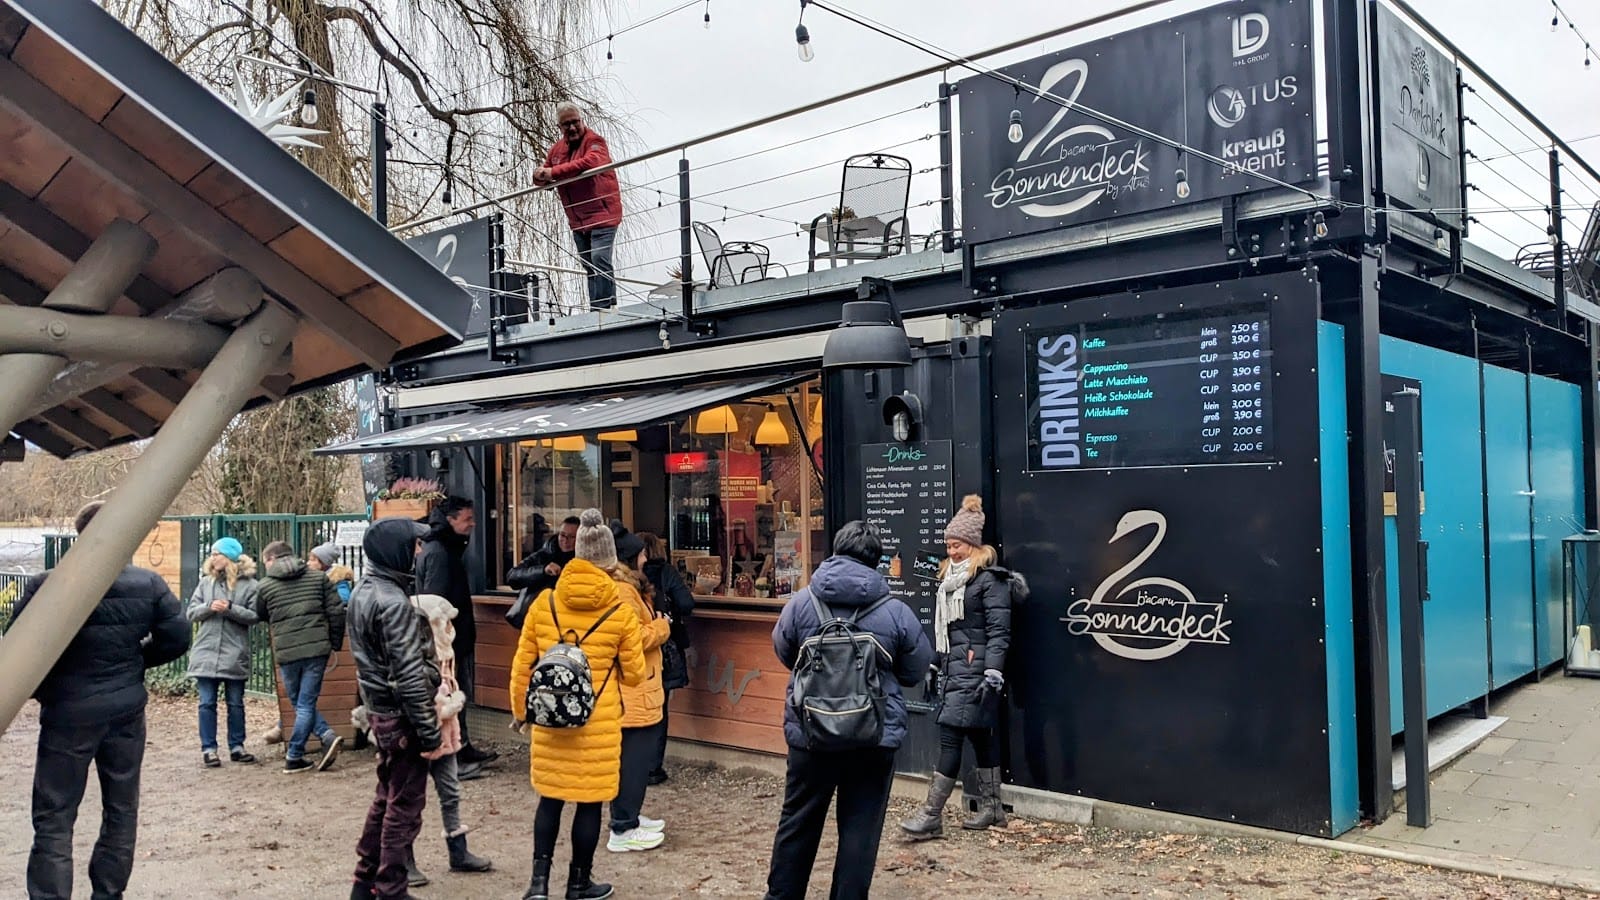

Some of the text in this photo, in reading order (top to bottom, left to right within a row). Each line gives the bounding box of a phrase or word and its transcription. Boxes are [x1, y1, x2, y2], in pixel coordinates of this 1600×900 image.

[1247, 53, 1270, 64] GROUP
[1228, 75, 1298, 112] ATUS
[1222, 127, 1286, 159] krauß
[1059, 143, 1099, 161] bacaru
[1222, 148, 1286, 175] event
[984, 142, 1150, 208] Sonnendeck
[1105, 183, 1119, 199] by
[1201, 327, 1217, 336] klein
[1231, 322, 1259, 333] 2,50 €
[1082, 338, 1106, 349] Kaffee
[1200, 337, 1218, 350] groß
[1231, 333, 1260, 344] 3,90 €
[1199, 353, 1218, 363] CUP
[1232, 350, 1260, 360] 3,50 €
[1083, 361, 1129, 375] Cappuccino
[1232, 366, 1261, 377] 3,90 €
[1200, 369, 1219, 379] CUP
[1083, 374, 1149, 388] Latte Macchiato
[1200, 385, 1220, 395] CUP
[1231, 382, 1261, 393] 3,00 €
[1037, 334, 1081, 466] DRINKS
[1084, 388, 1154, 403] Heiße Schokolade
[1203, 401, 1220, 410] klein
[1231, 398, 1262, 409] 3,00 €
[1084, 405, 1129, 418] Milchkaffee
[1233, 410, 1262, 420] 3,90 €
[1203, 412, 1220, 424] groß
[1201, 428, 1221, 437] CUP
[1232, 425, 1263, 436] 2,00 €
[1085, 432, 1118, 445] Espresso
[1085, 447, 1099, 457] Tee
[1202, 443, 1222, 453] CUP
[1233, 442, 1263, 452] 2,00 €
[882, 446, 926, 463] Drinks
[1137, 590, 1176, 607] bacaru
[1059, 599, 1232, 644] Sonnendeck
